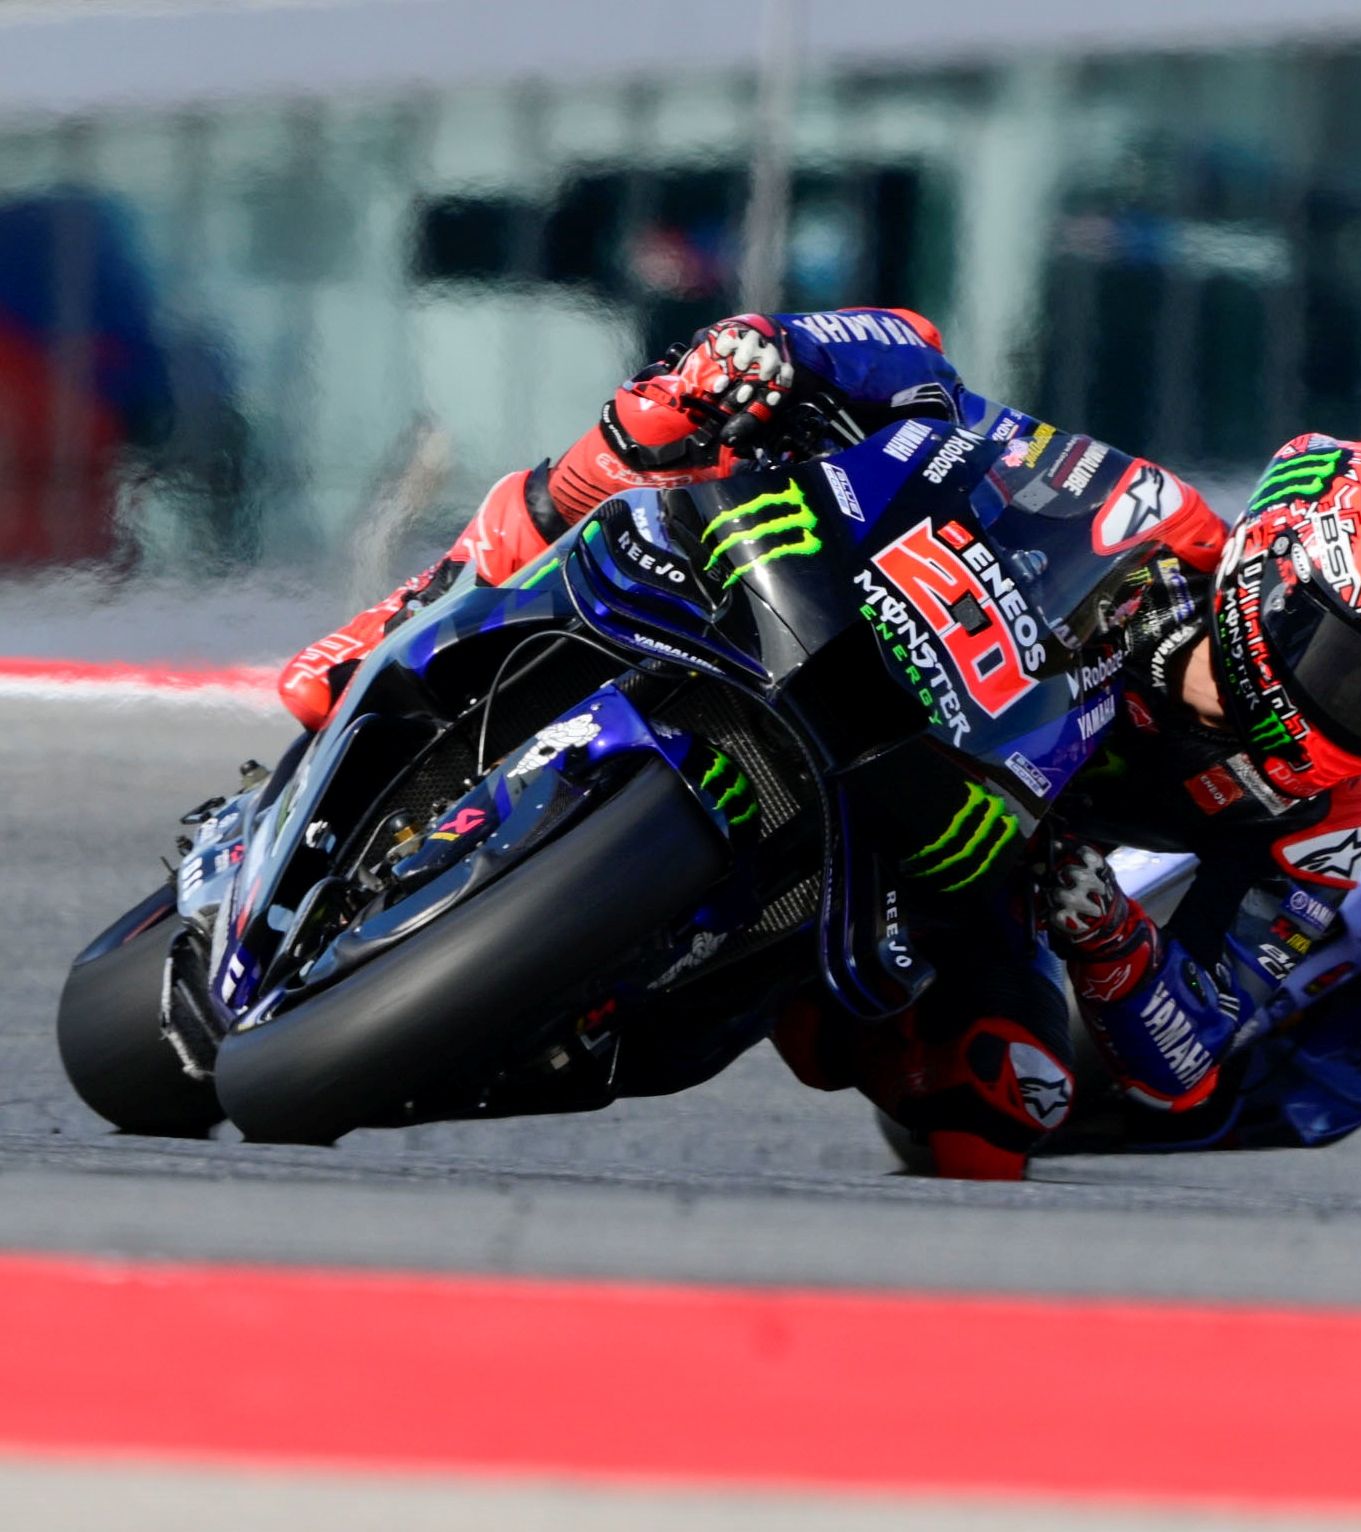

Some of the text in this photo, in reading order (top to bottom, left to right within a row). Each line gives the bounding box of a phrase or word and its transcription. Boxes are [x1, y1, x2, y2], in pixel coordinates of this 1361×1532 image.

[792, 313, 928, 349] YAMAHA
[882, 419, 933, 462] YAMAHA
[922, 434, 975, 484] Roboze
[617, 530, 687, 583] REEJO
[962, 541, 1046, 672] ENEOS
[853, 568, 971, 748] MONSTER
[858, 603, 943, 726] ENERGY
[1081, 649, 1123, 692] Roboze
[1077, 694, 1116, 741] YAMAHA
[886, 890, 913, 968] REEJO
[1139, 980, 1215, 1090] YAMAHA
